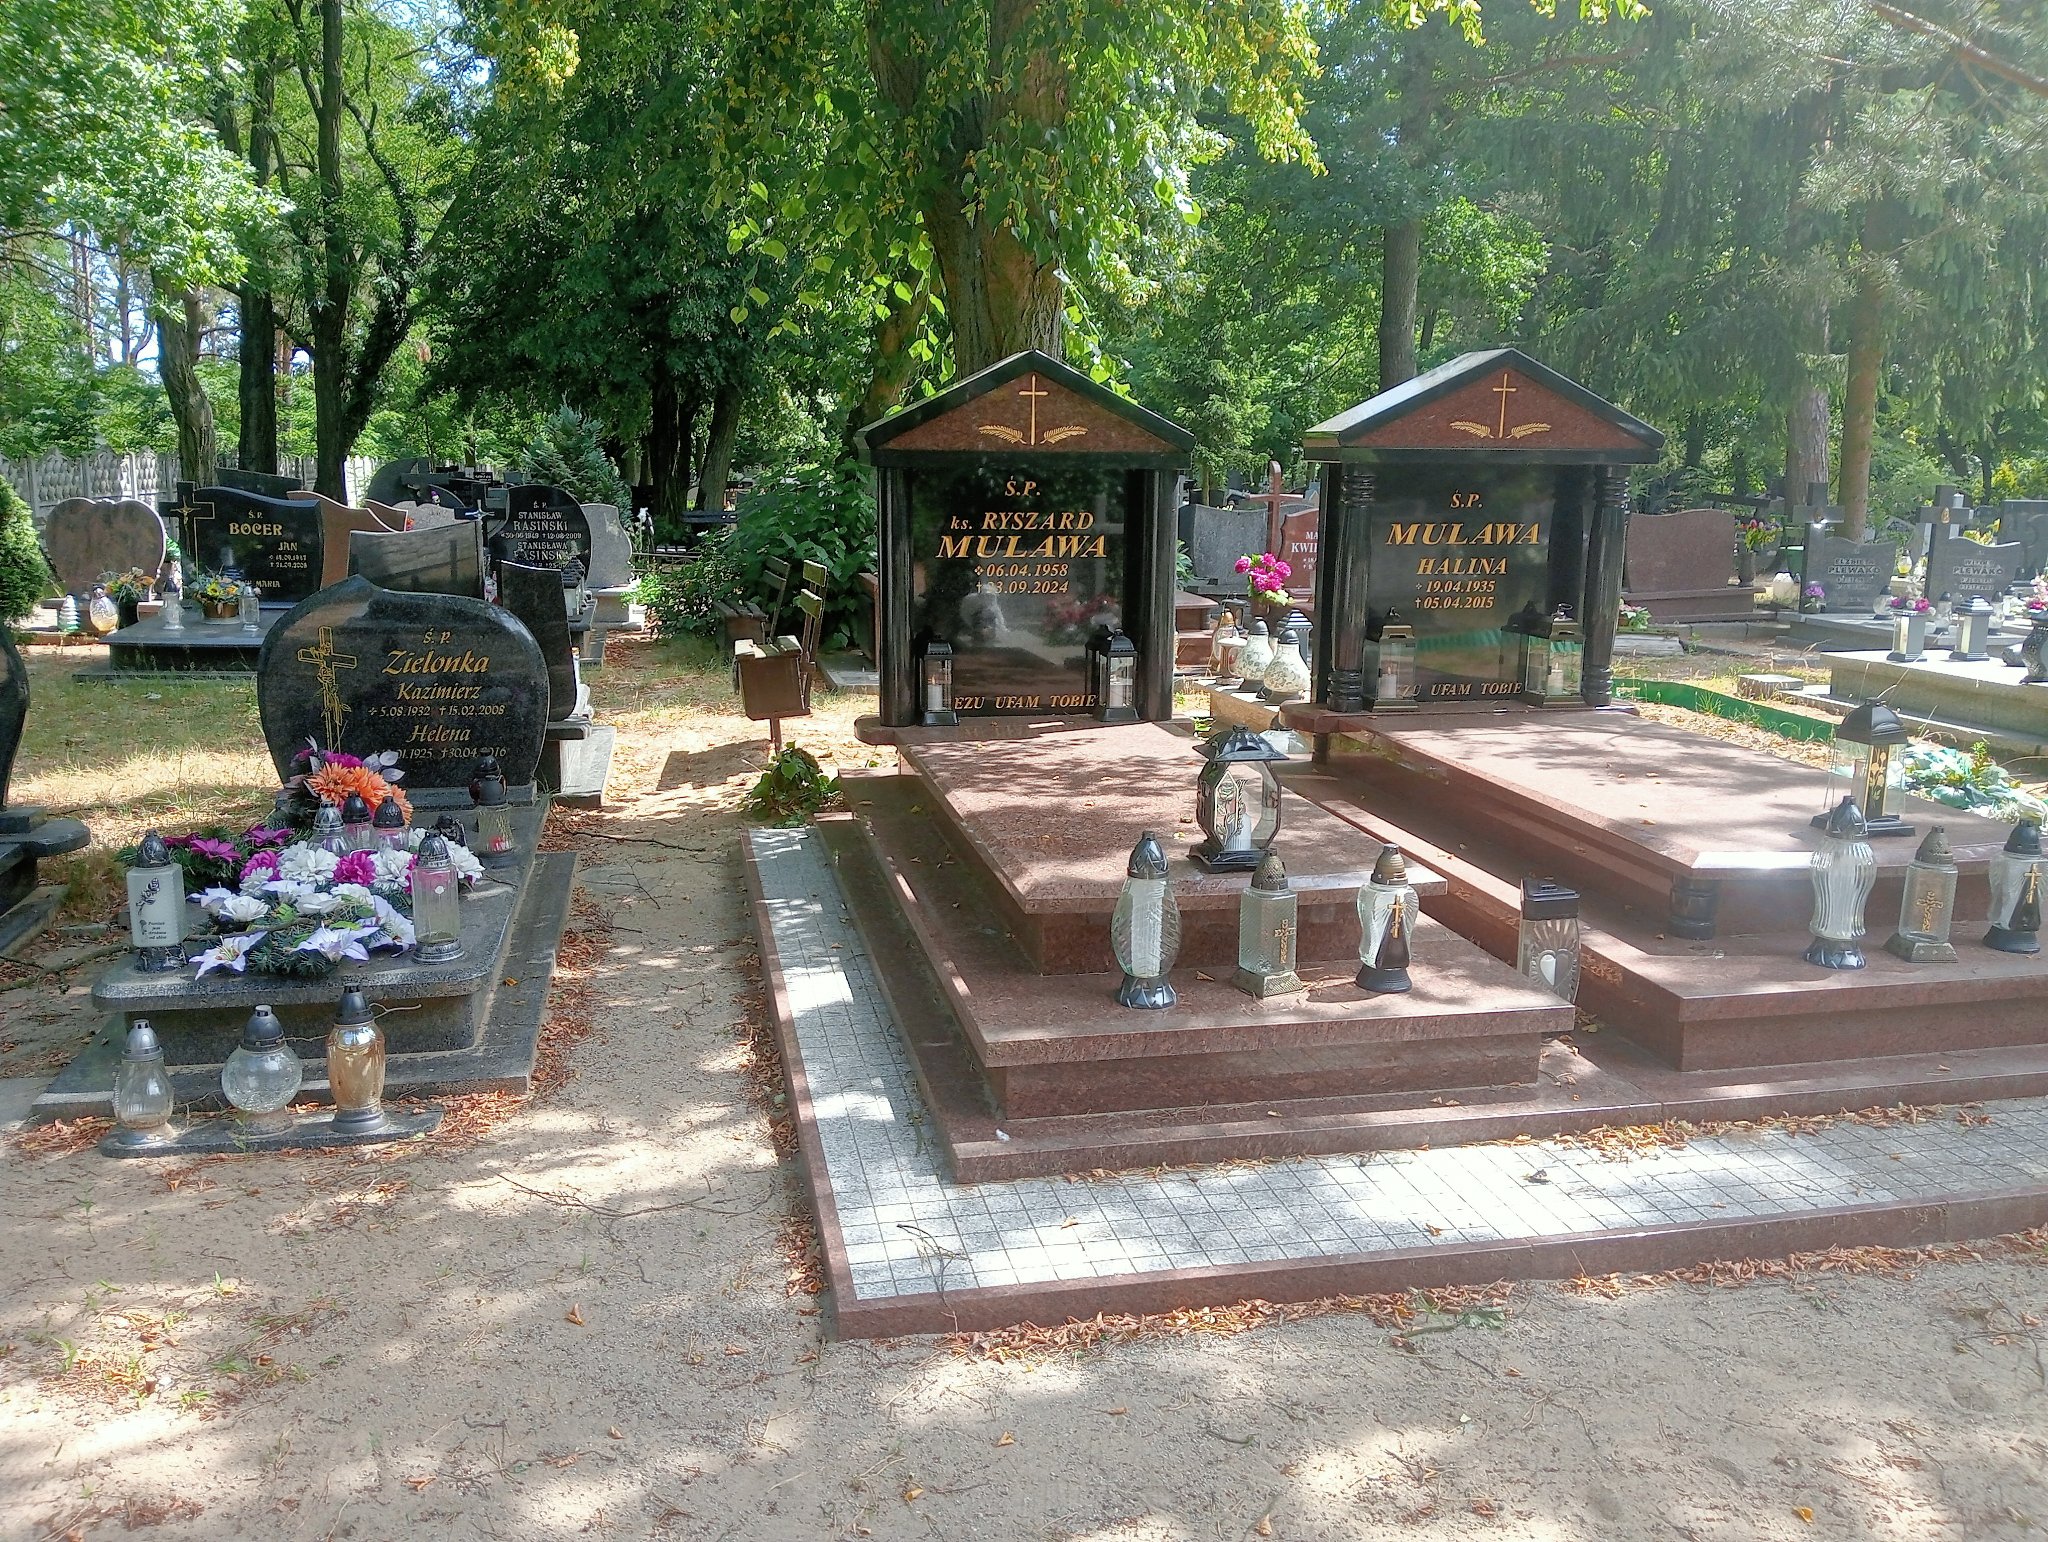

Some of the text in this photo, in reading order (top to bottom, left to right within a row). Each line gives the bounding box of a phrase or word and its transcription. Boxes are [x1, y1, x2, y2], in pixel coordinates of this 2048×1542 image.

[1005, 476, 1041, 497] Ś.P.
[1450, 489, 1483, 508] Ś.P.
[518, 511, 563, 520] STANISŁAW
[951, 512, 1094, 530] ks. RYSZARD
[513, 519, 568, 531] RASIŃSKI
[1385, 523, 1540, 545] MULAWA
[278, 541, 298, 551] JAN
[517, 541, 568, 550] STANISŁAWA
[935, 535, 1107, 558] MULAWA
[986, 564, 1069, 577] 06.04.1958
[1417, 557, 1507, 575] HALINA
[255, 580, 281, 588] MARIA
[1426, 580, 1496, 593] 19.04.1935
[1423, 596, 1495, 609] 05.04.2015
[382, 649, 490, 675] Zielonka
[397, 682, 483, 700] Kazimierz
[1431, 683, 1473, 696] UFAM
[1480, 682, 1523, 695] TOBIE
[995, 696, 1041, 709] UFAM
[1050, 694, 1097, 708] TOBIE
[449, 705, 506, 716] 15.02.2008
[406, 724, 471, 743] Helena
